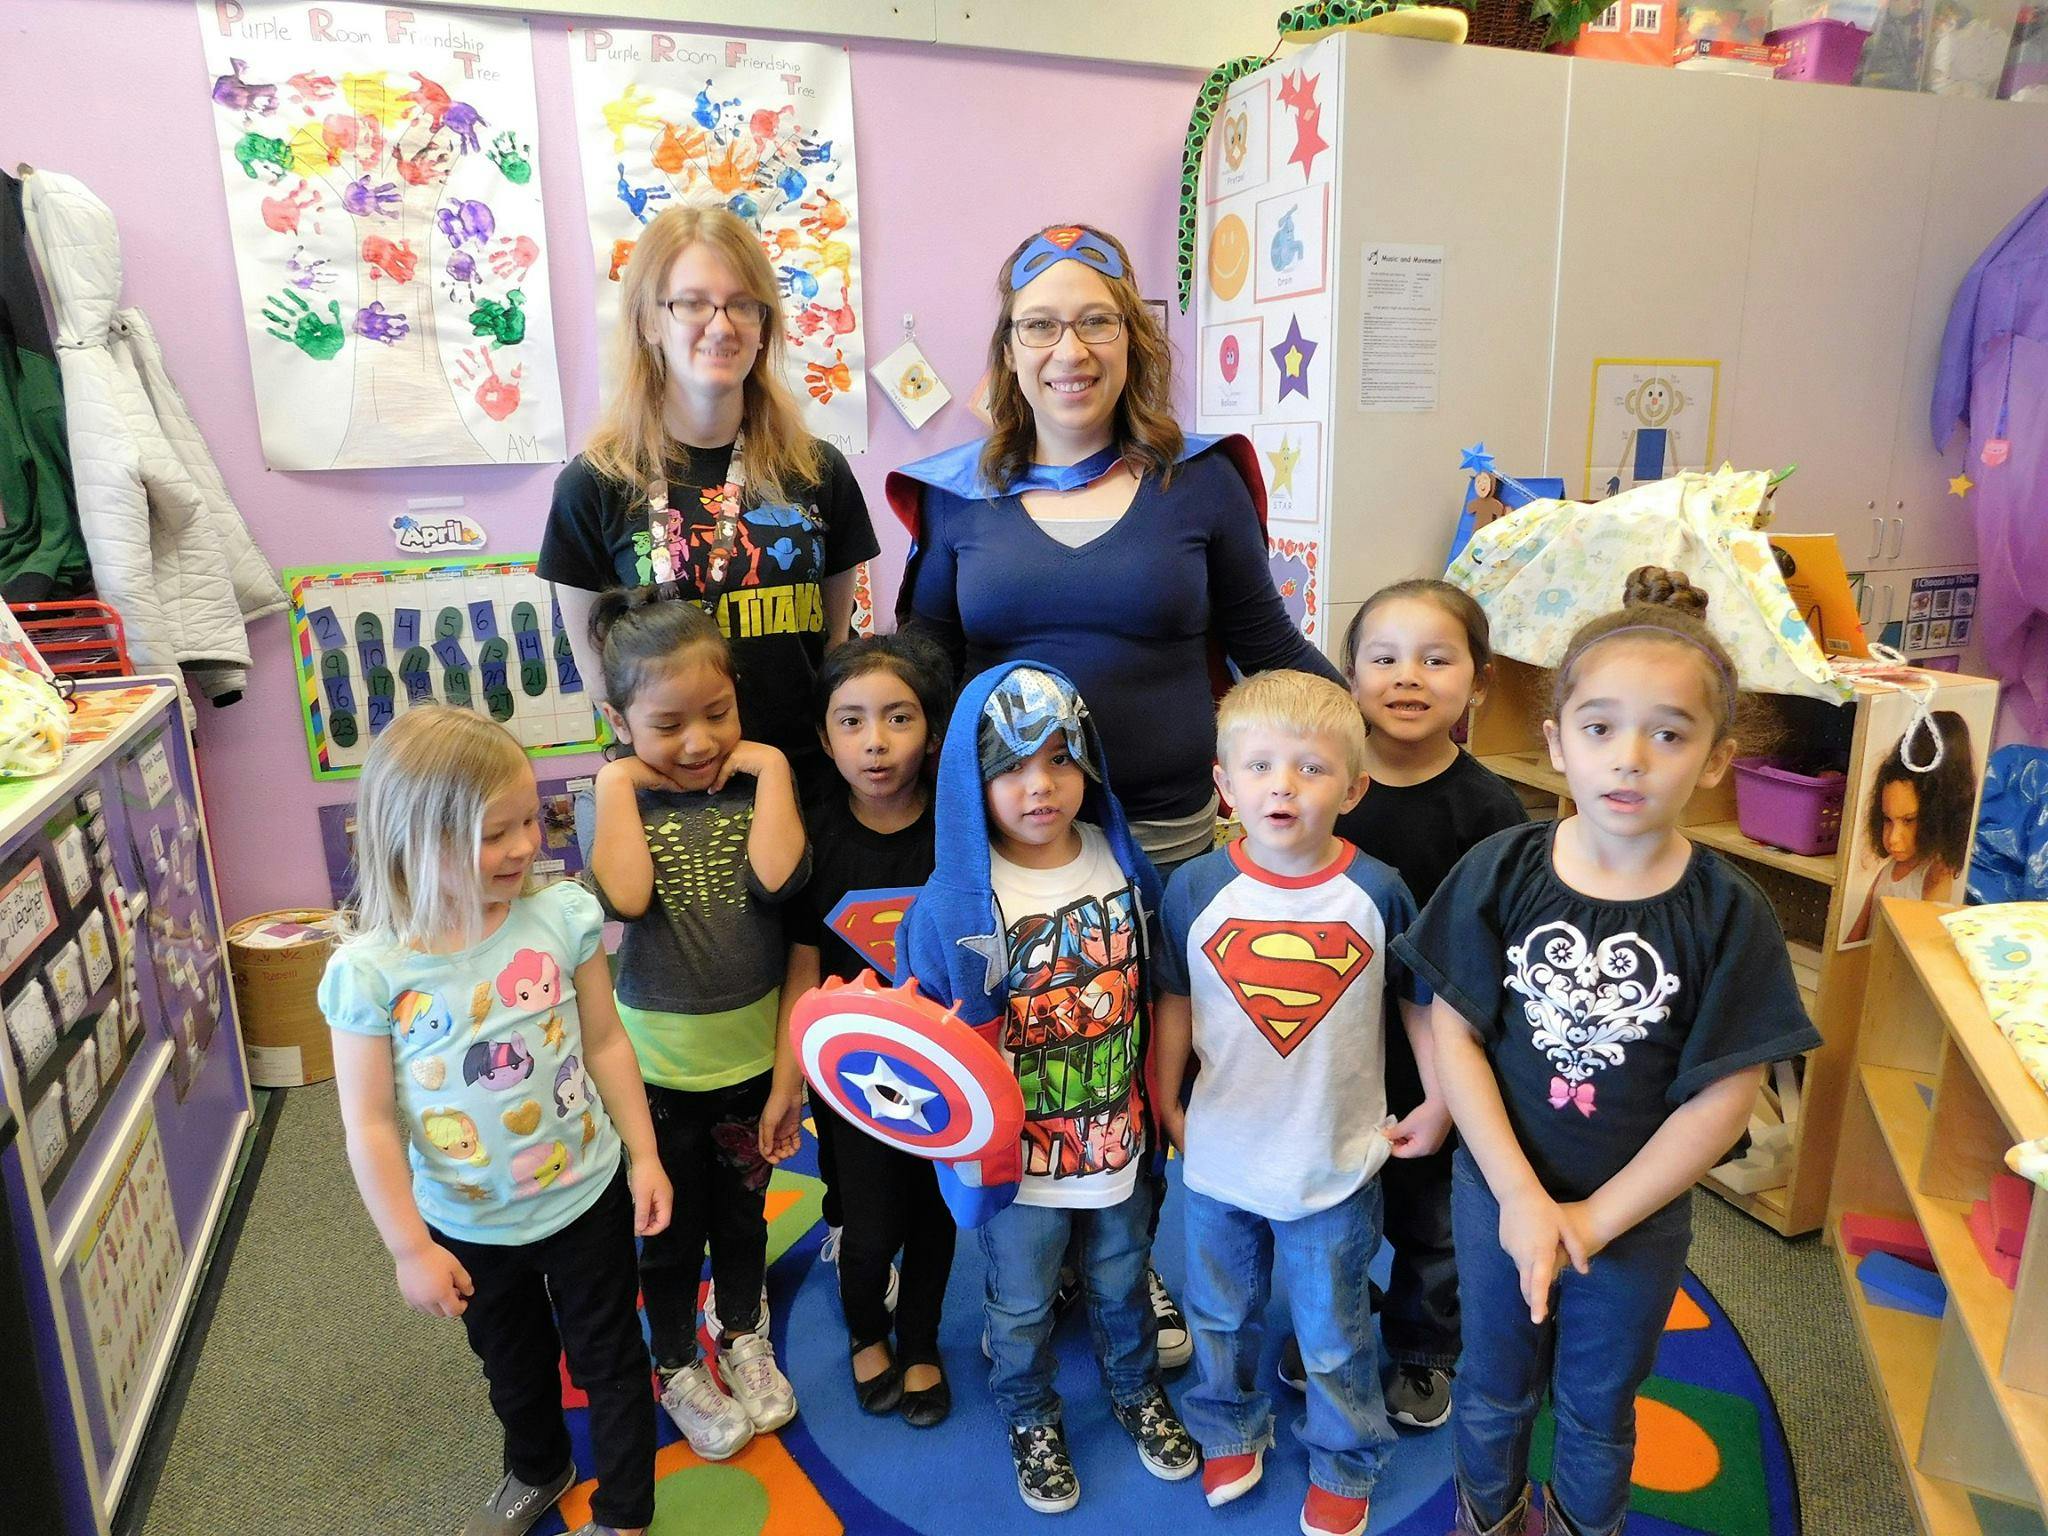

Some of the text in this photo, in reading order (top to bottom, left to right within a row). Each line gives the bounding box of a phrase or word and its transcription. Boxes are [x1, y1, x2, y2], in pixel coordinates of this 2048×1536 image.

[215, 0, 292, 41] Purple
[307, 7, 372, 42] Room
[453, 51, 499, 80] Tree
[584, 29, 801, 72] Purple Room Friendship
[781, 73, 815, 99] Tree
[507, 433, 539, 462] AM
[400, 519, 464, 548] April
[315, 616, 337, 640] 2
[361, 621, 375, 641] 3
[398, 614, 413, 642] 4
[440, 616, 457, 638] 5
[475, 608, 489, 631] 6
[517, 613, 530, 632] 7
[728, 582, 824, 638] TITANS
[325, 655, 341, 677] 9
[363, 648, 384, 670] 10
[407, 653, 422, 673] 11
[519, 636, 540, 662] 14
[328, 684, 349, 709] 16
[373, 675, 389, 696] 17
[449, 672, 466, 692] 19
[523, 667, 541, 686] 21
[331, 717, 354, 738] 23
[369, 702, 393, 727] 24
[1016, 1030, 1140, 1118] HUL
